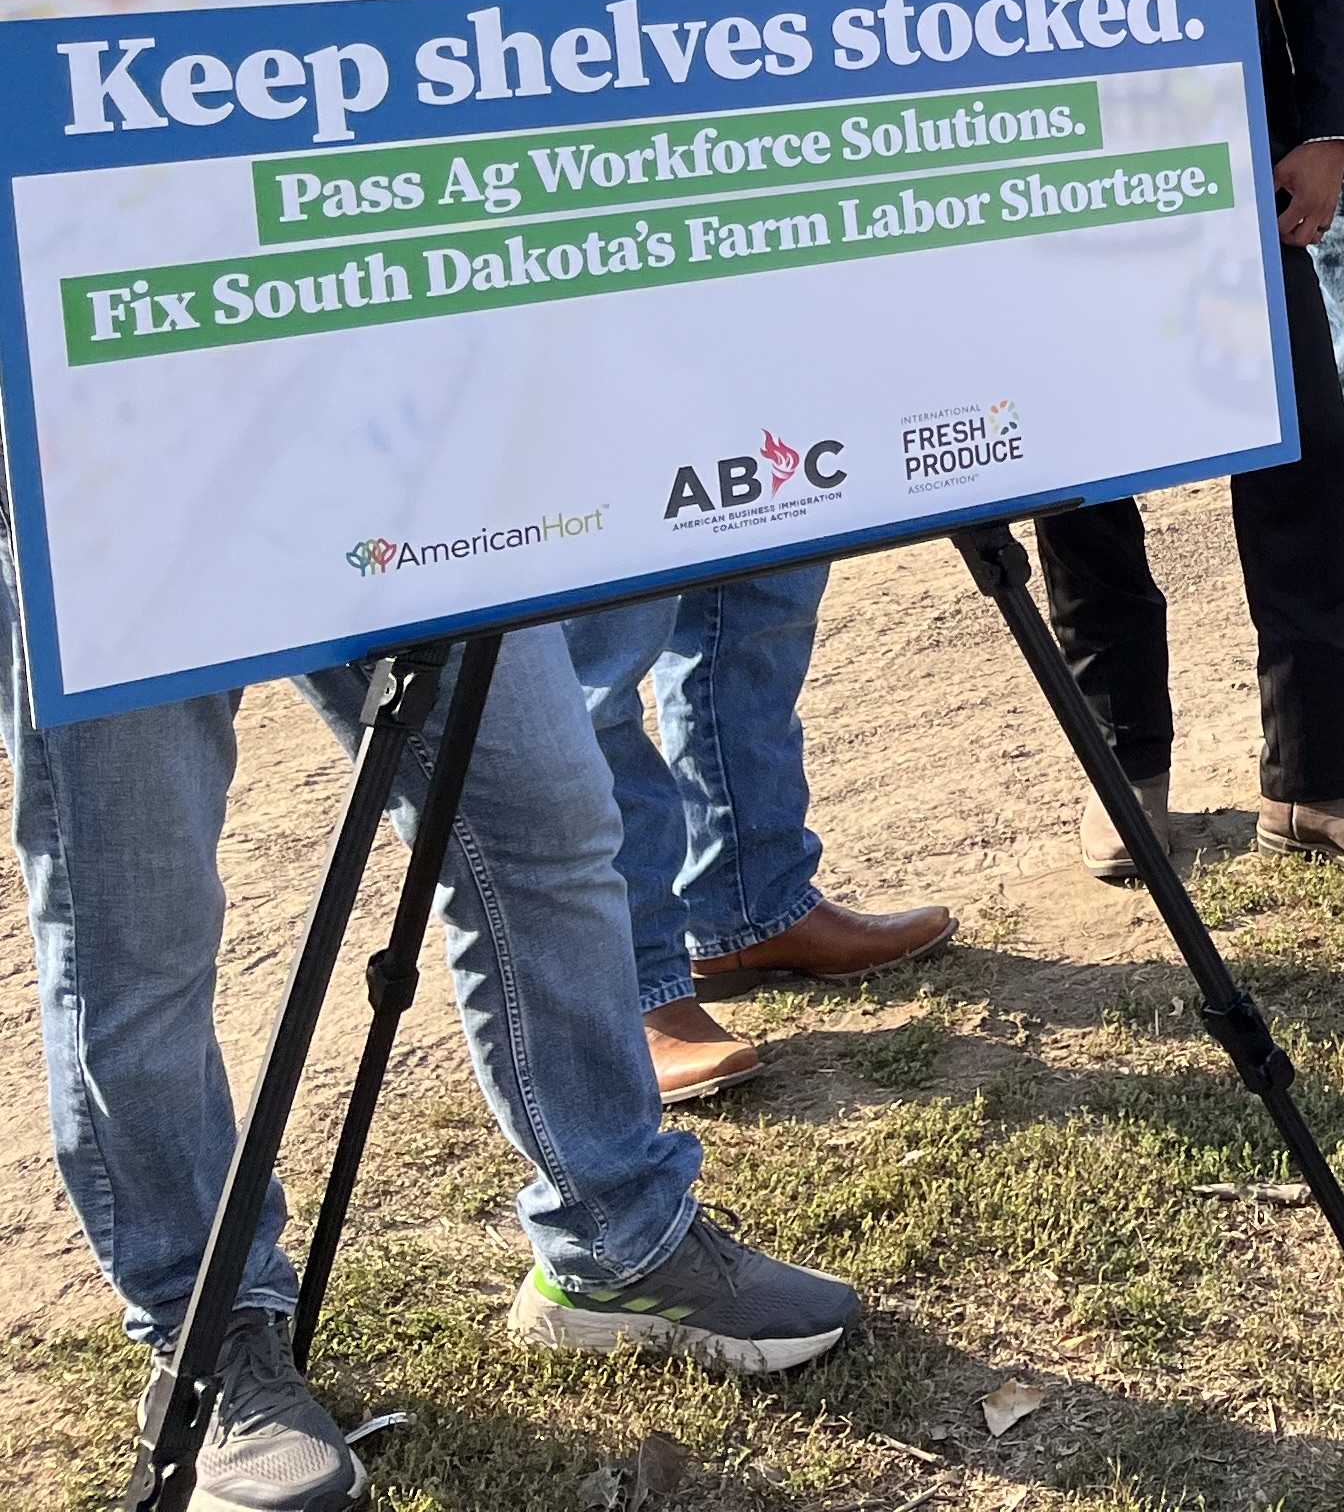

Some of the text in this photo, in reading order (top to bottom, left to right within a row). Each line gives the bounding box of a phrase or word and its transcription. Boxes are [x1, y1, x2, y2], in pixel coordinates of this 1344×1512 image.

[57, 38, 388, 142] Keep
[276, 101, 1085, 223] Pass Ag Workforce Solutions.
[87, 167, 1218, 341] Fix South Dakota's Farm Labor Shortage.
[900, 404, 981, 425] INTERNATIONAL
[903, 417, 985, 454] FRESH
[906, 437, 1023, 481] PRODUCE
[672, 491, 842, 531] AMERICAN BUSINESS IMMIGRATION
[713, 508, 807, 533] COALITION ACTION
